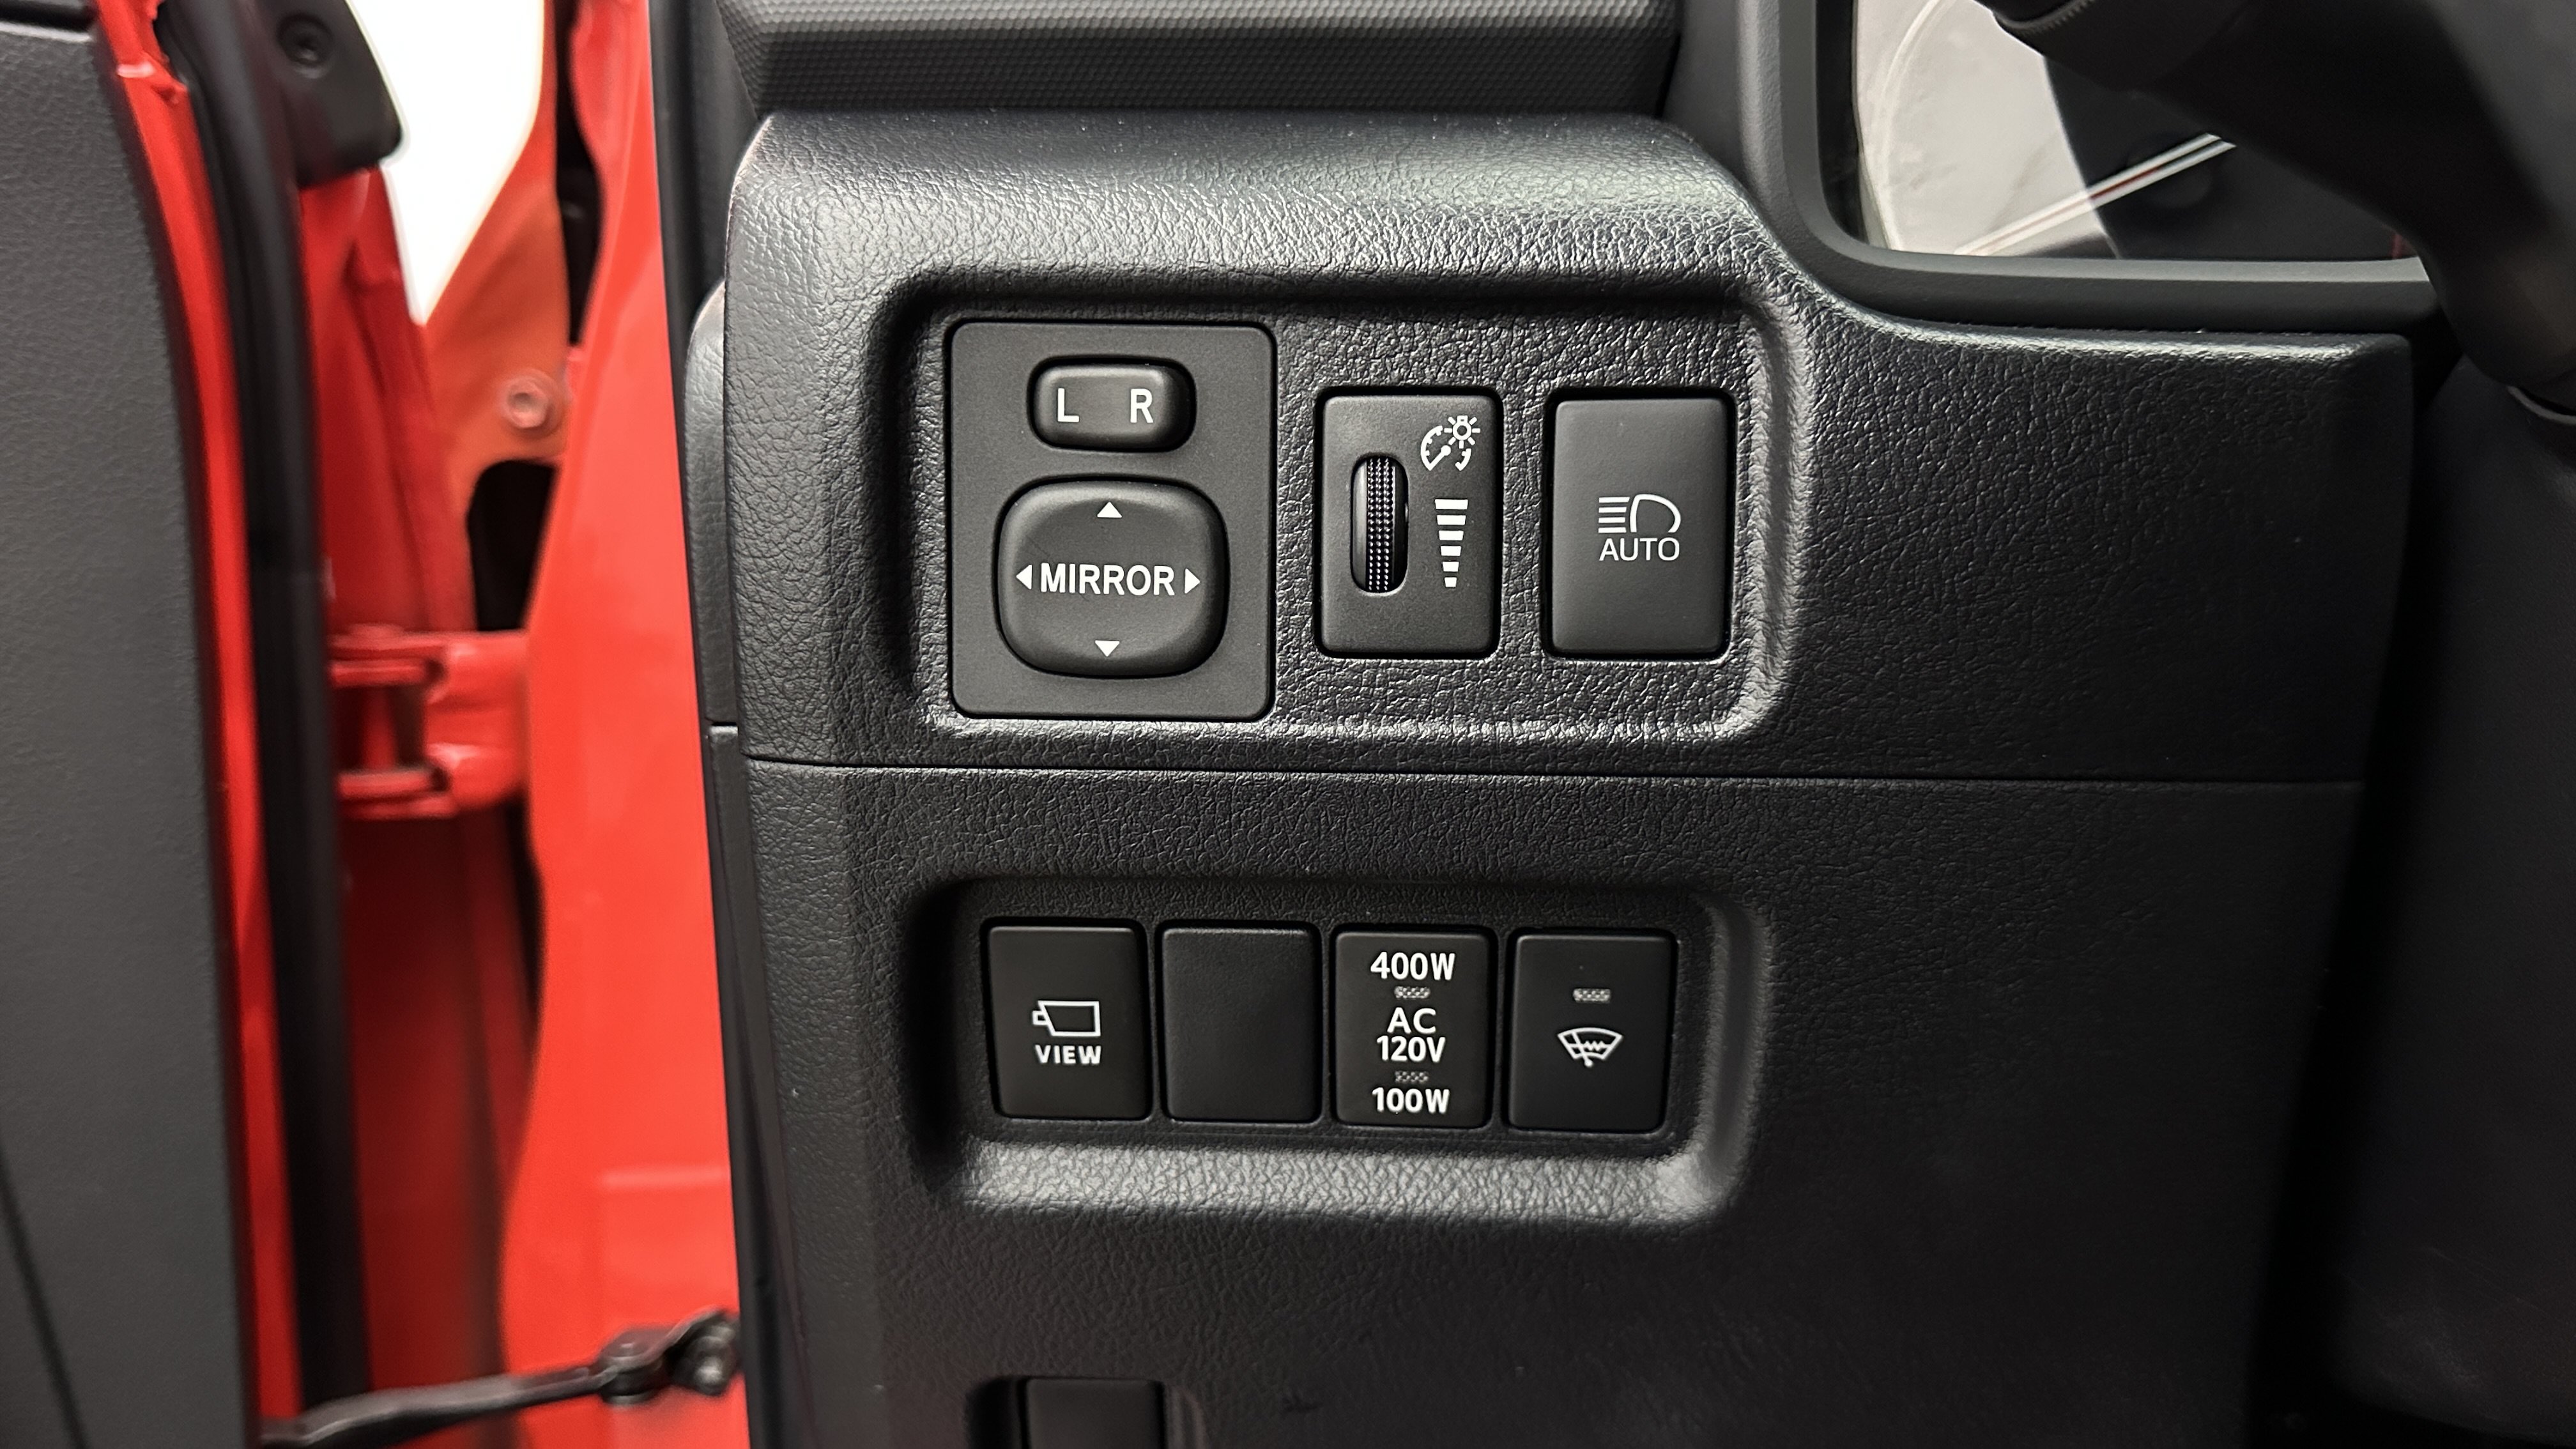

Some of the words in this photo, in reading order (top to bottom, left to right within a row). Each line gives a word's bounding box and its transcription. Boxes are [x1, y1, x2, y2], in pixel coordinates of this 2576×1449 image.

[1056, 387, 1080, 423] L
[1130, 388, 1154, 424] R
[1598, 537, 1680, 562] AUTO
[1039, 562, 1176, 597] MIRROR
[1370, 951, 1456, 981] 400W
[1386, 1007, 1437, 1034] AC
[1035, 1045, 1102, 1065] VIEW
[1376, 1035, 1446, 1063] 120V
[1372, 1087, 1450, 1115] 100W
